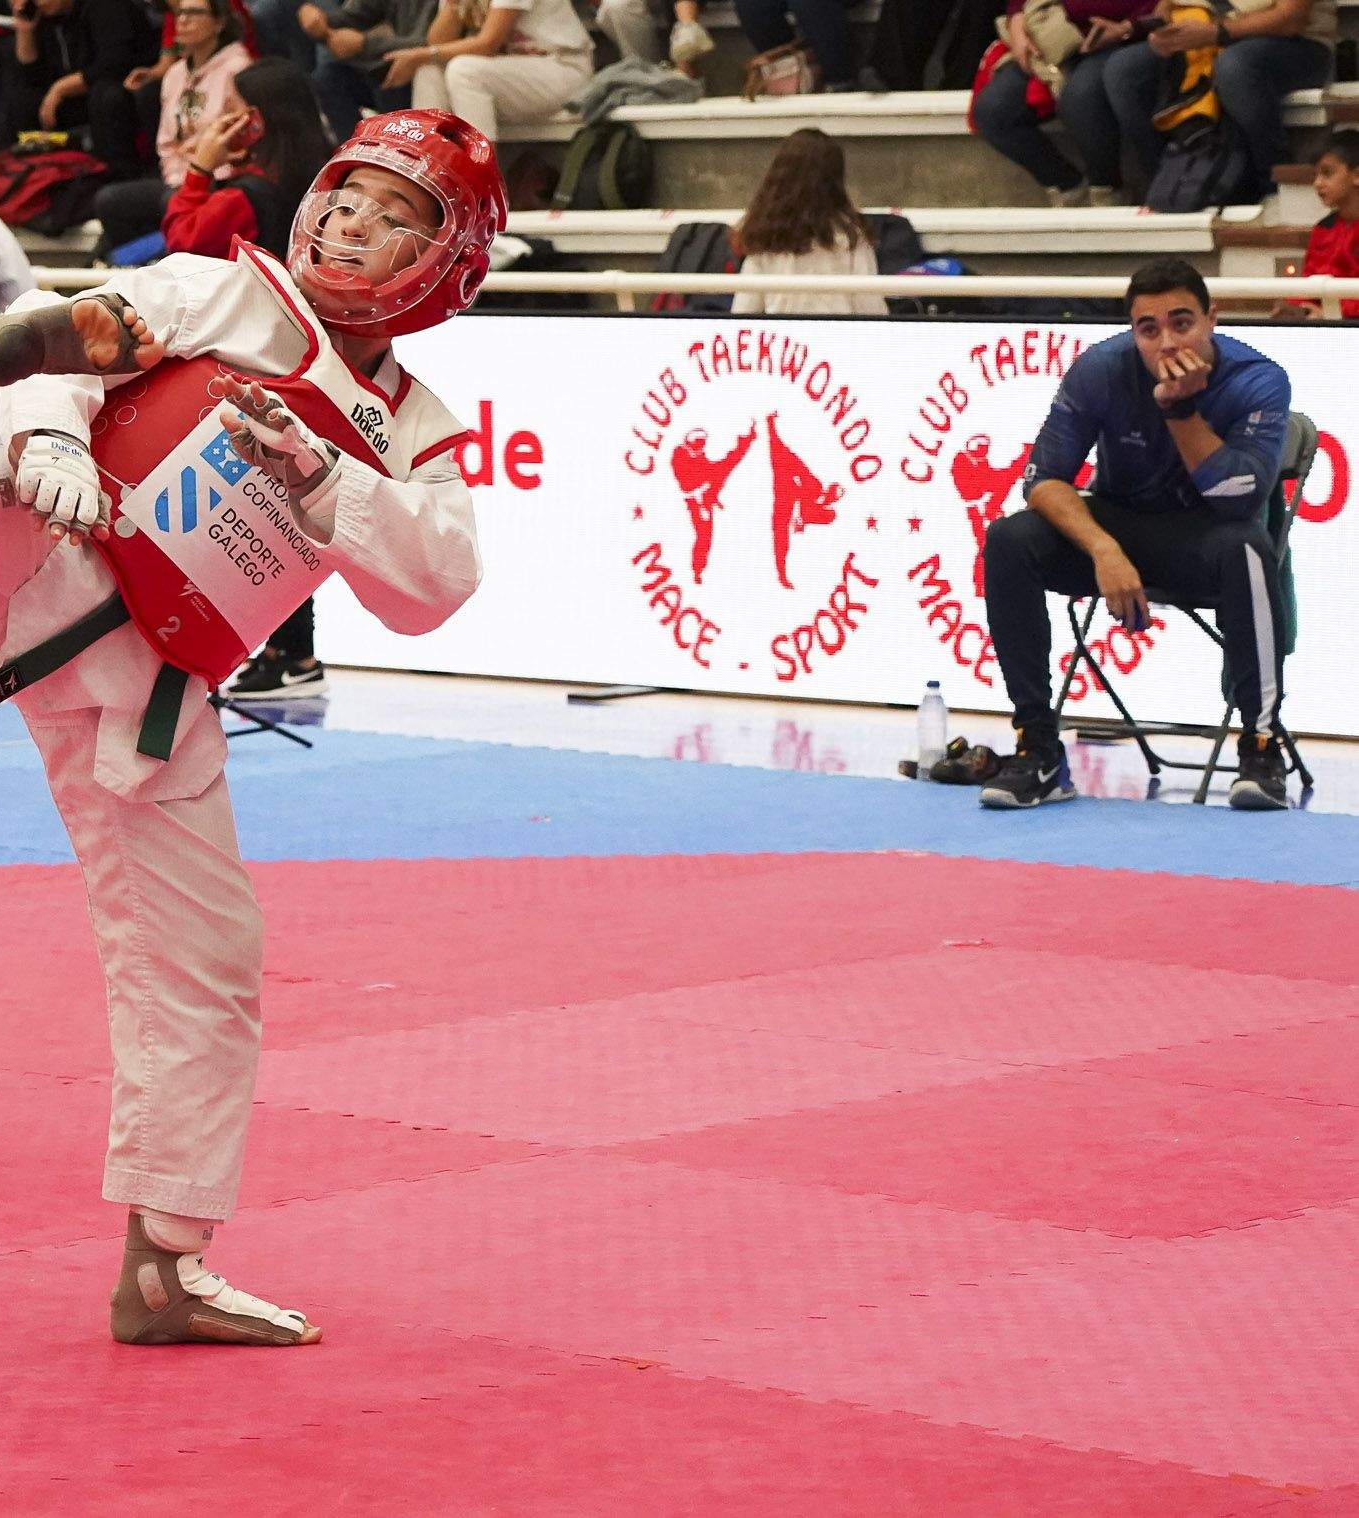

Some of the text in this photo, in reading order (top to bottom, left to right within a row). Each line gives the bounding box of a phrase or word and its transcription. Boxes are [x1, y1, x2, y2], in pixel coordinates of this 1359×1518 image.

[351, 402, 390, 456] Daedo
[453, 399, 544, 490] de
[625, 329, 882, 482] CLUB TAEKWONDO
[900, 372, 968, 483] CLUB
[242, 482, 321, 572] COFINANCIADO
[257, 467, 291, 509] PROX
[208, 523, 266, 587] GALEGO
[221, 508, 285, 580] DEPORTE
[156, 616, 181, 641] 2
[631, 542, 880, 682] MACE SPORT
[907, 553, 997, 687] MACE
